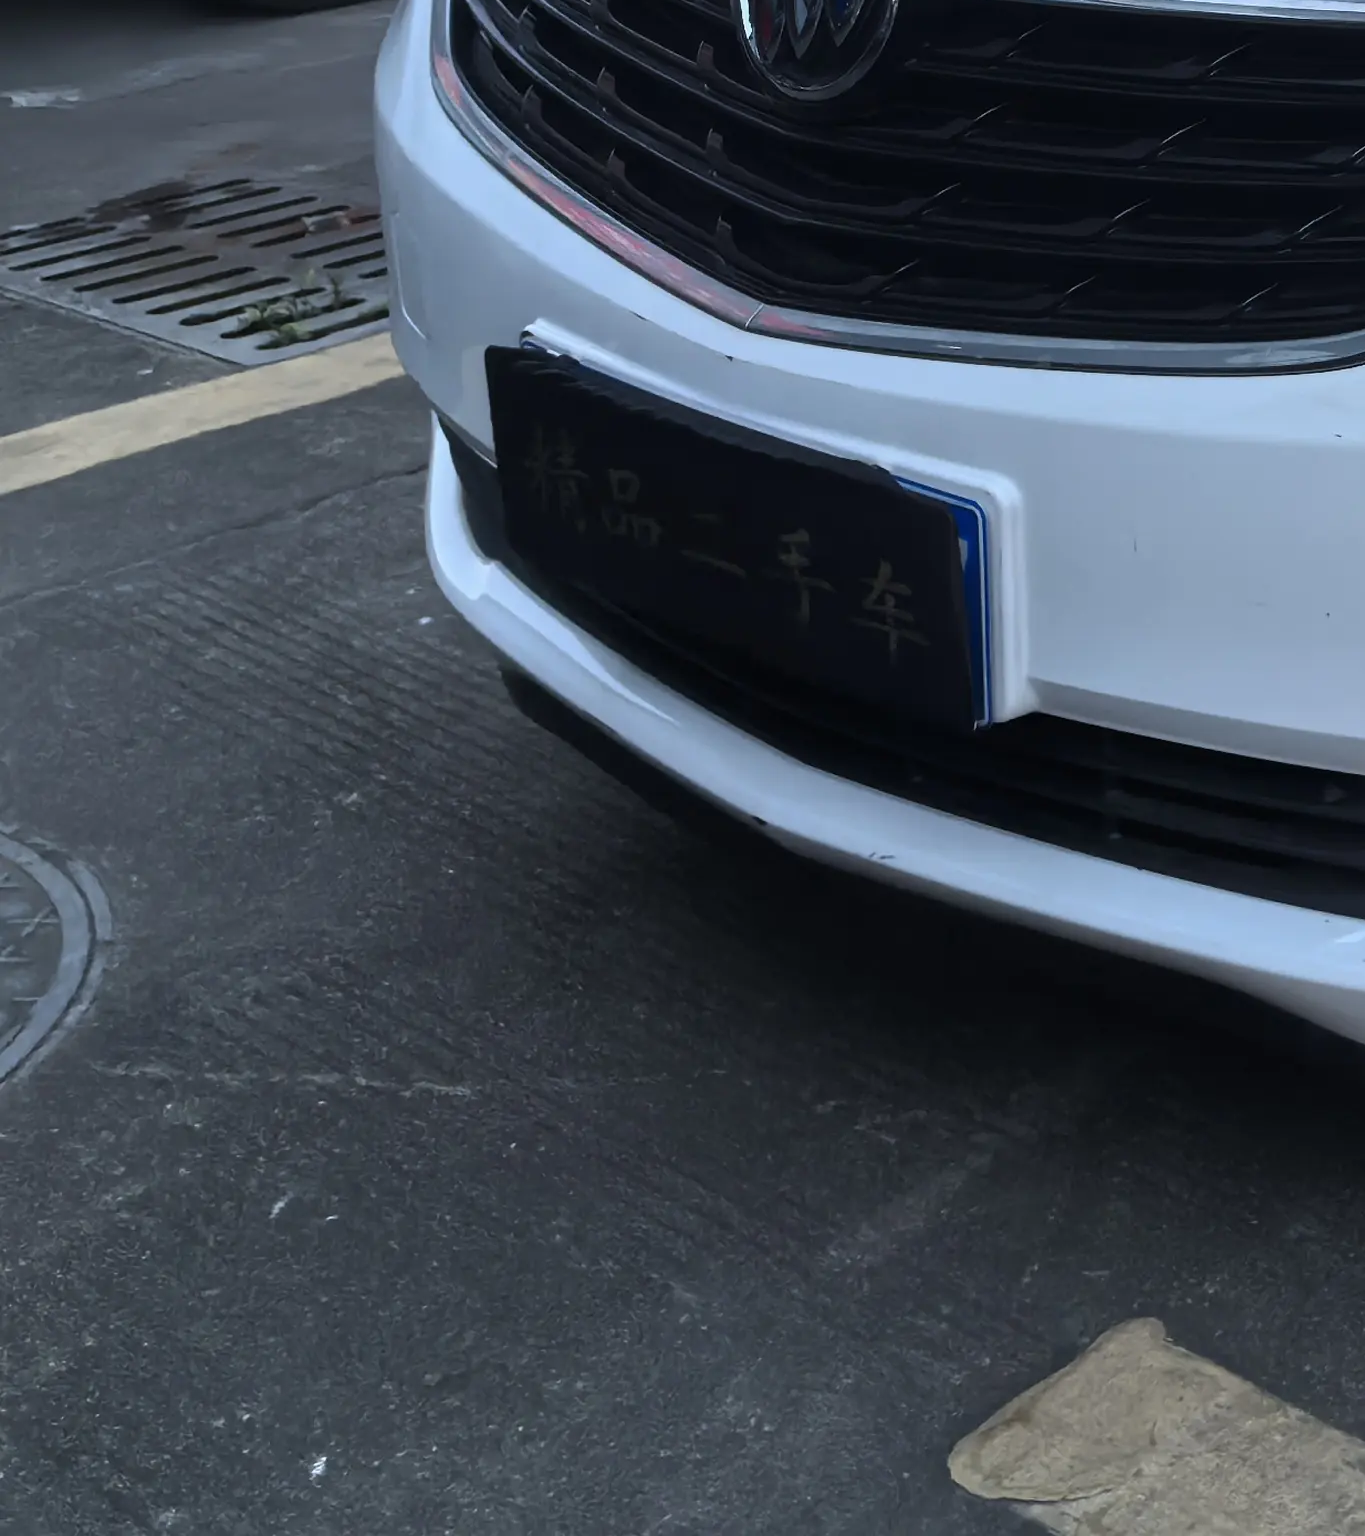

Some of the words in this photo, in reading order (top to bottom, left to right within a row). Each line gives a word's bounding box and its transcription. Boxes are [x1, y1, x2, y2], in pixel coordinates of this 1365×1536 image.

[523, 423, 931, 668] 精品二手车
